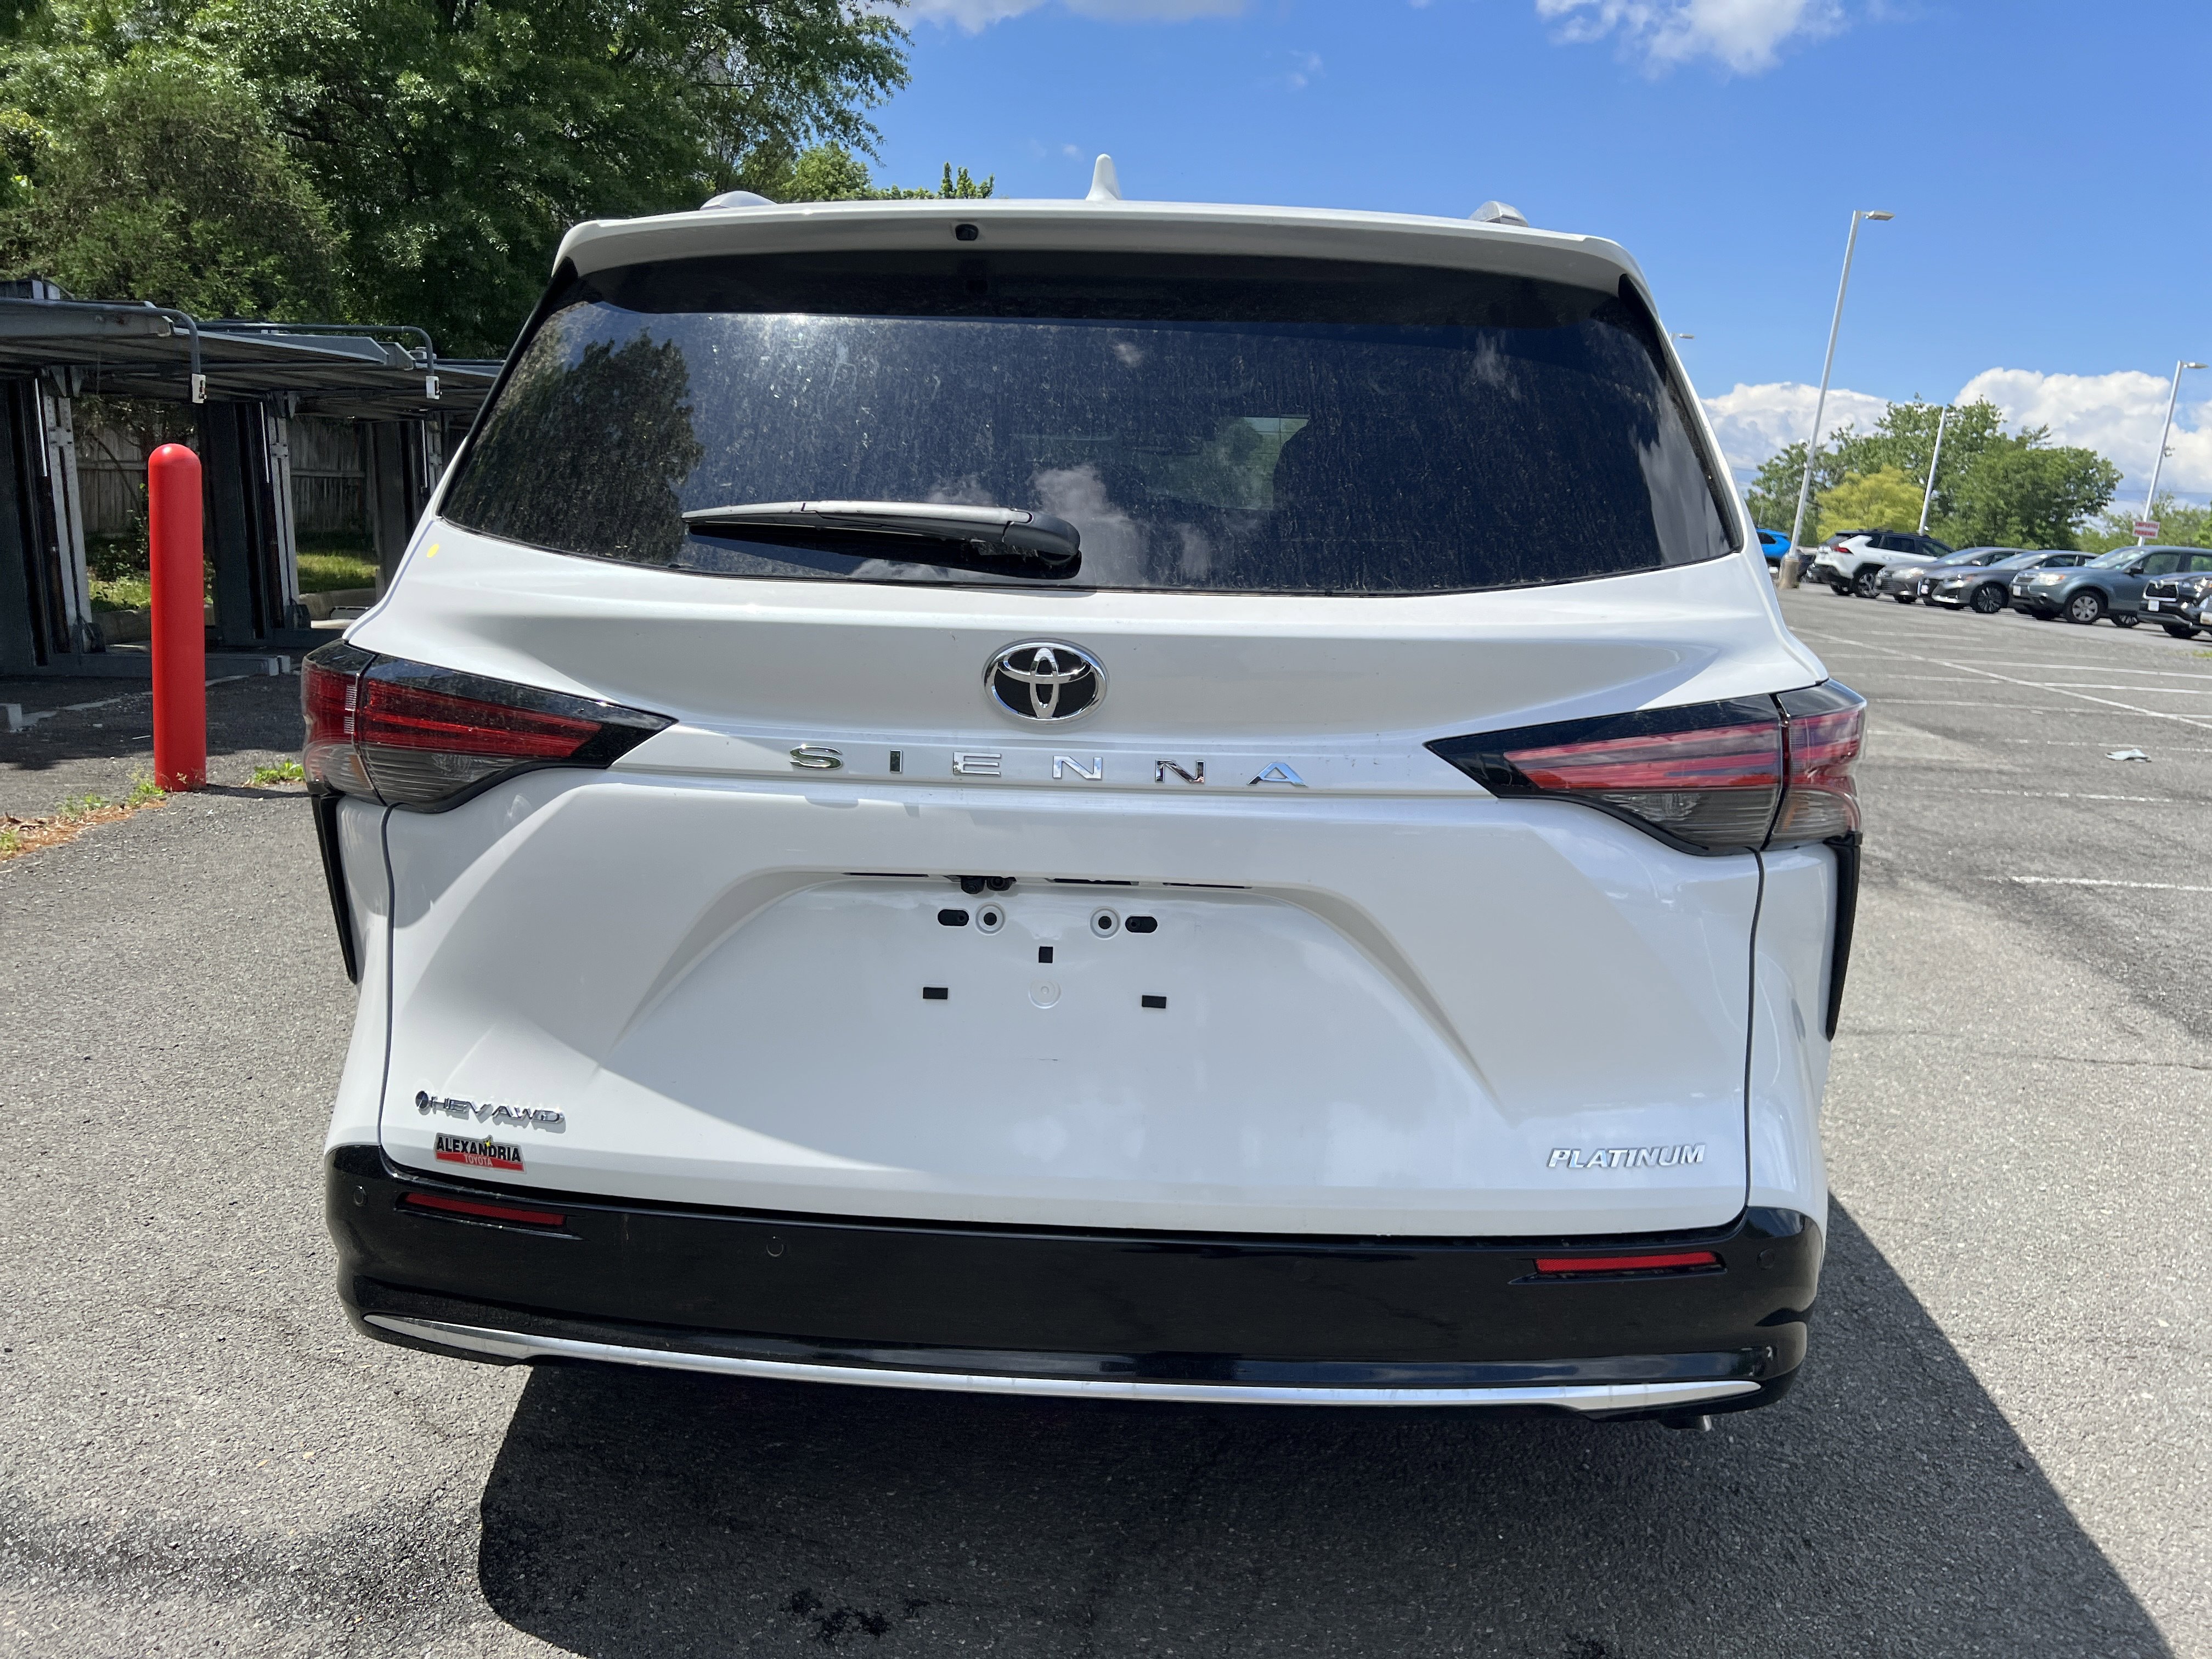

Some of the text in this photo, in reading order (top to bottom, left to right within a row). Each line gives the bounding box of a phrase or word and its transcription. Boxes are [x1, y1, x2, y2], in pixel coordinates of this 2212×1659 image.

[789, 742, 1308, 788] SIENNA
[436, 1136, 521, 1162] ALEXANDRIA
[464, 1154, 493, 1167] TOYOTA
[1547, 1143, 1706, 1168] PLATINUM
